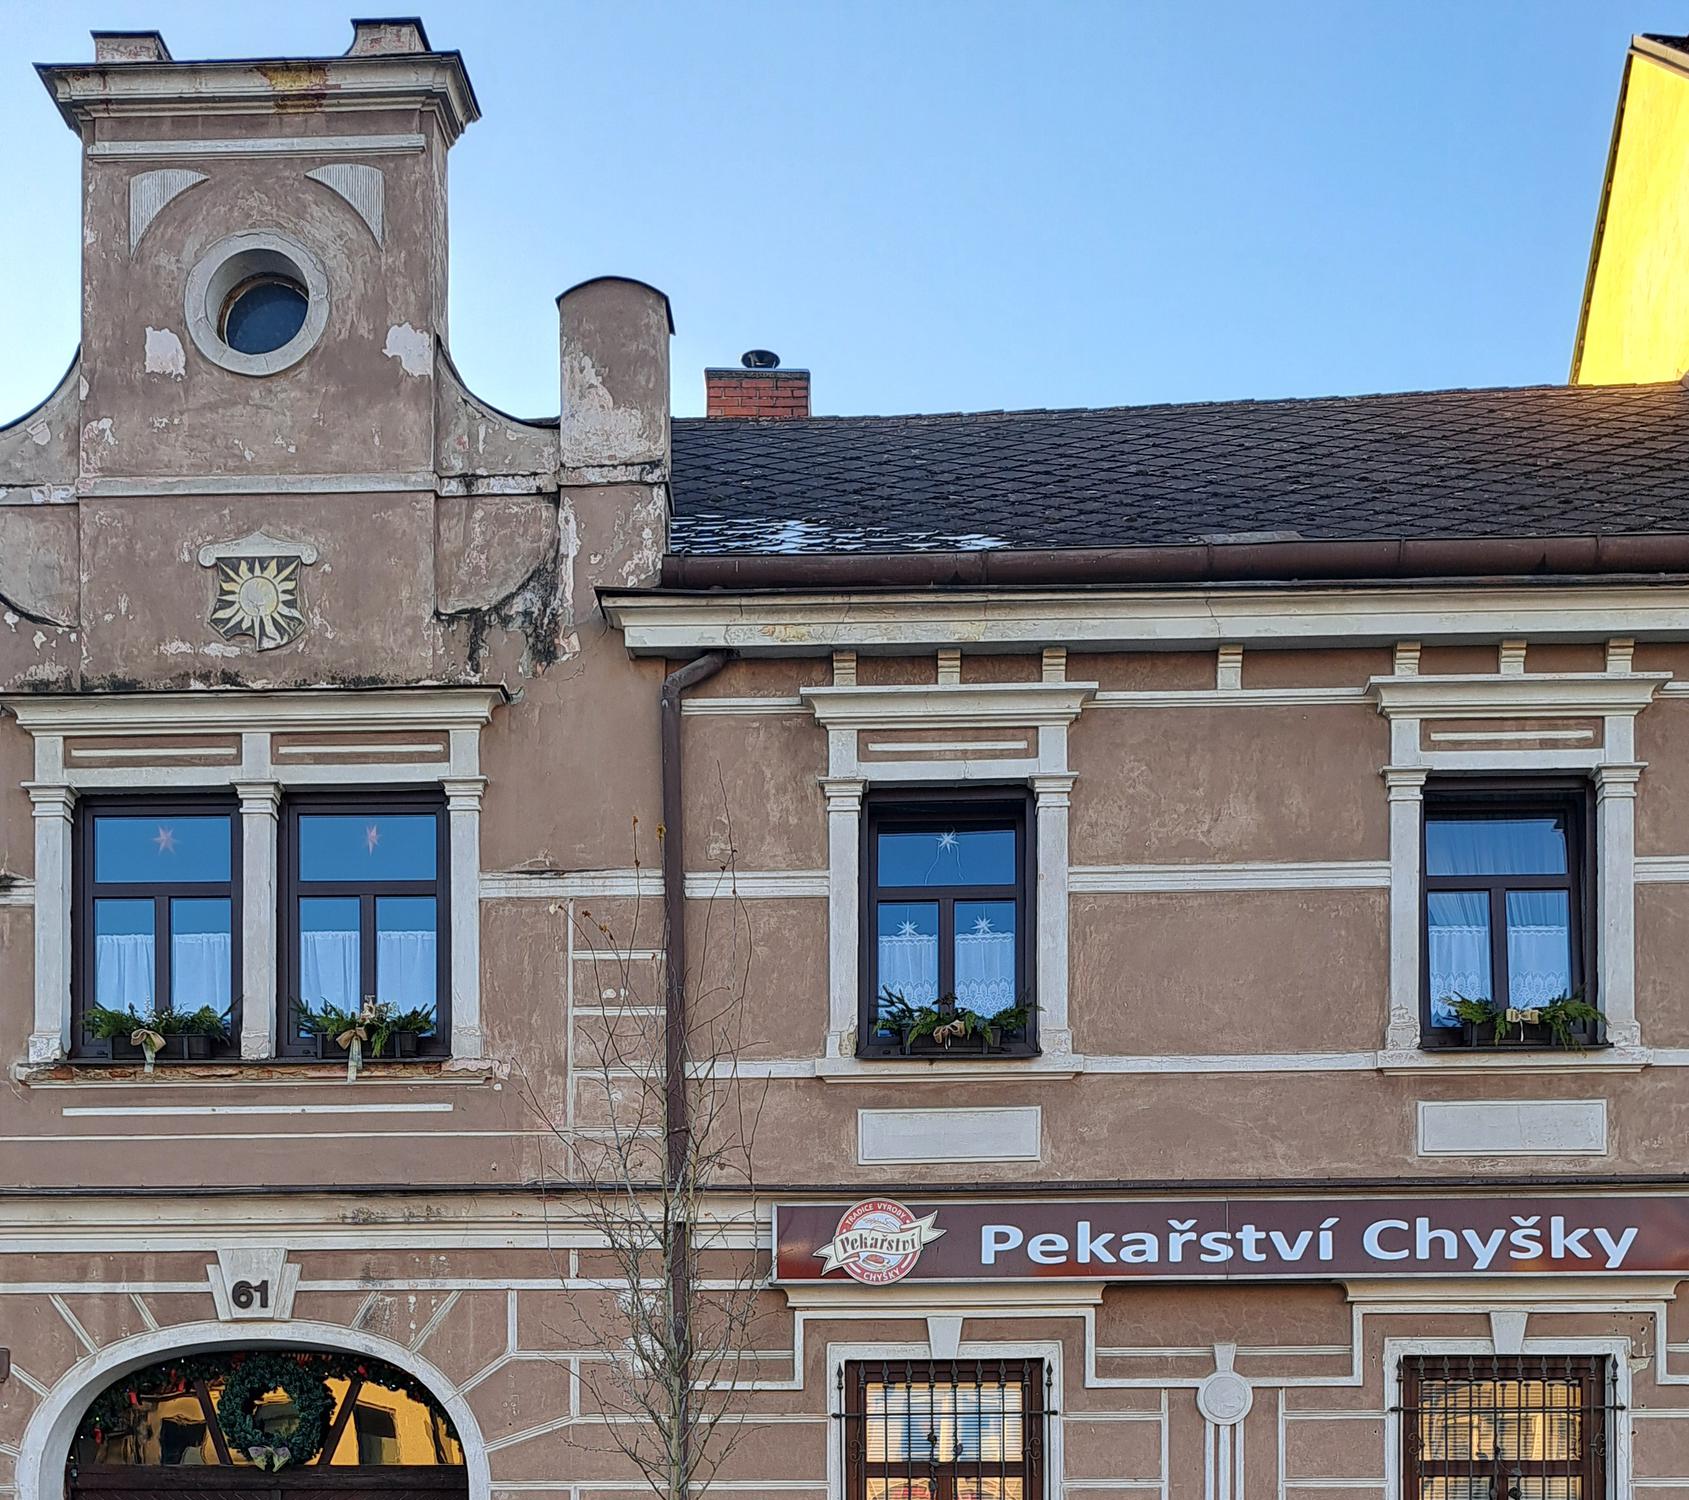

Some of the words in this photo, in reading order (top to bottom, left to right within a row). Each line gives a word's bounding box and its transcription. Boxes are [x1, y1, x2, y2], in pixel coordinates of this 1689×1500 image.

[846, 1203, 874, 1226] TRADICE
[877, 1202, 907, 1219] VÝROBY
[838, 1233, 917, 1255] Pekařství
[980, 1217, 1340, 1265] Pekařství
[1362, 1216, 1639, 1270] Chyšky
[863, 1267, 901, 1281] CHYŠKY
[231, 1279, 269, 1309] 61
